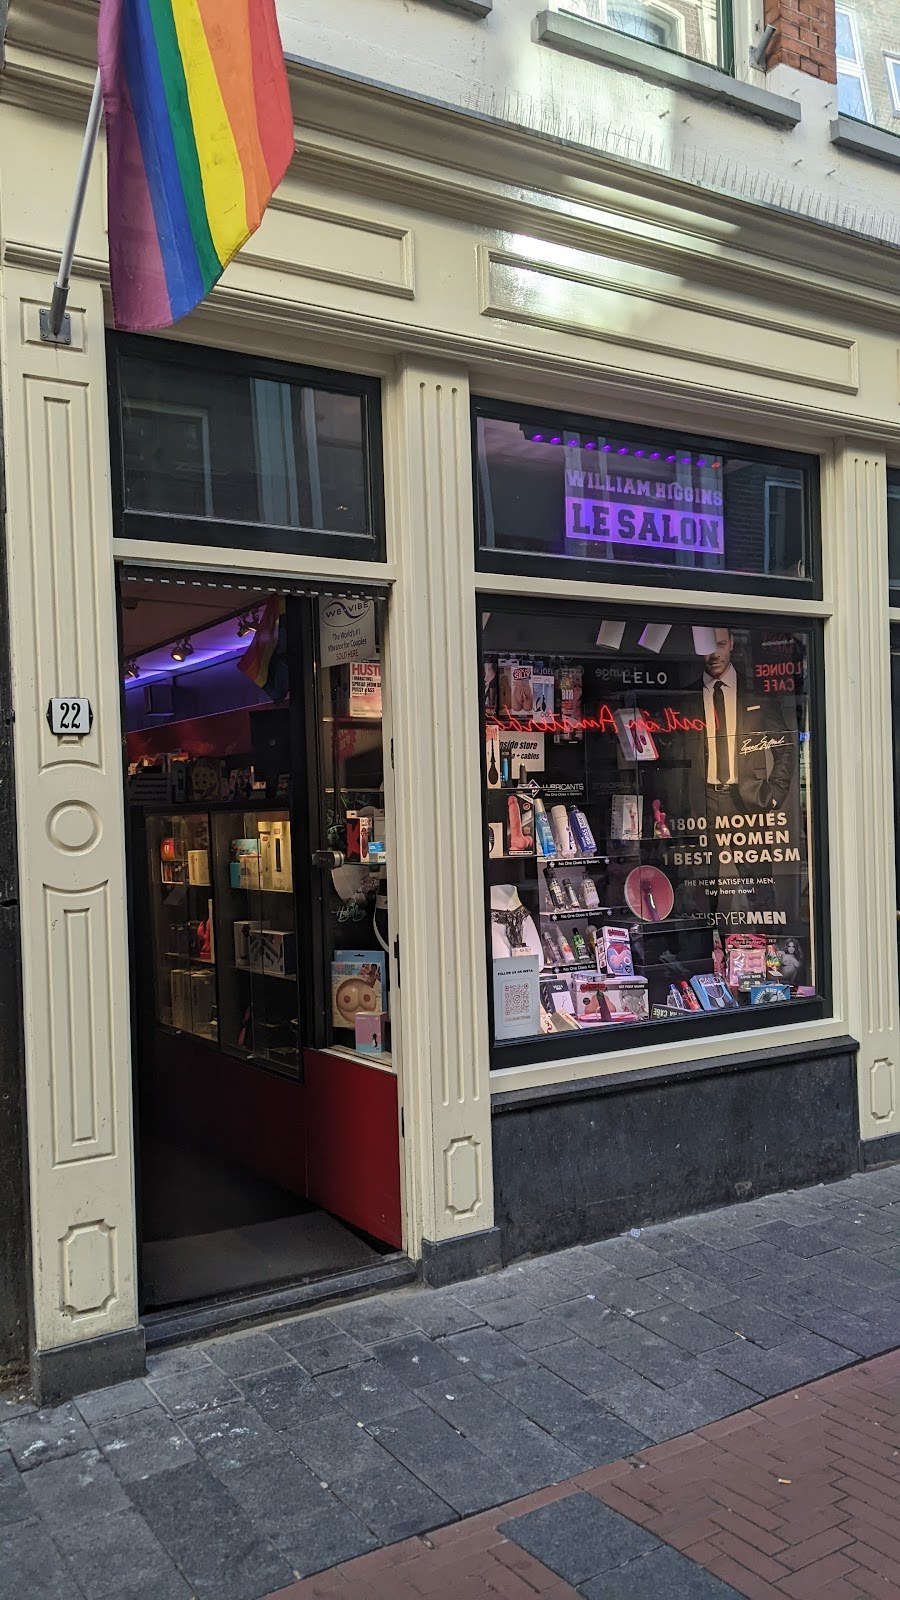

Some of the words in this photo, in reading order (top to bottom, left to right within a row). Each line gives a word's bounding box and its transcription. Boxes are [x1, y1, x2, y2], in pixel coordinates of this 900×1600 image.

[567, 470, 650, 497] WILLIAM
[655, 481, 723, 506] HIGGINS
[572, 502, 610, 536] LE
[617, 509, 719, 549] SALON
[328, 642, 344, 652] Vibrator
[350, 637, 367, 648] Couples
[336, 652, 348, 660] SOLD
[348, 649, 359, 658] HERE
[514, 671, 530, 680] SILLY
[540, 667, 554, 675] JOEL
[622, 671, 668, 685] LELO
[60, 702, 81, 729] 22
[519, 740, 538, 750] store
[542, 783, 584, 791] LUBRICANTS
[669, 817, 707, 831] 1800
[715, 812, 788, 829] MOVIES
[715, 830, 790, 847] WOMEN
[662, 853, 668, 865] 1
[673, 851, 713, 866] BEST
[718, 847, 801, 864] ORGASM
[684, 879, 697, 887] THE
[717, 878, 754, 886] SATISFYER
[756, 877, 776, 885] MEN.
[738, 887, 755, 895] now!
